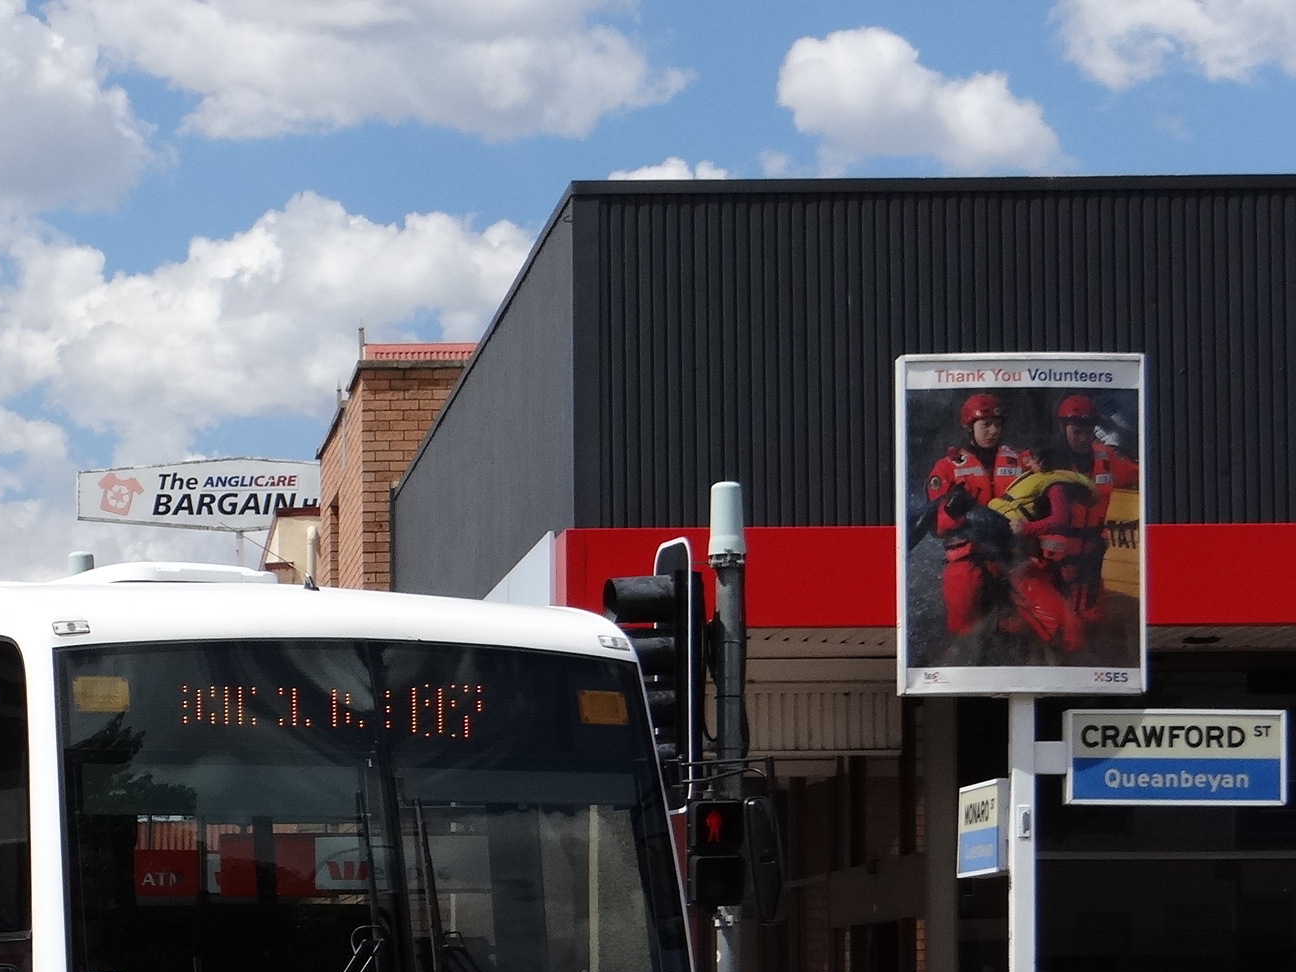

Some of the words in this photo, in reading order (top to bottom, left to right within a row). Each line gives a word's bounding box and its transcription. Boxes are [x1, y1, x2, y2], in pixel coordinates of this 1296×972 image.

[935, 369, 986, 383] Thank
[992, 368, 1022, 382] You
[1027, 368, 1113, 383] Volunteers
[158, 473, 199, 491] The
[203, 475, 298, 489] ANGLICARE
[152, 492, 297, 516] BARGAIN
[1105, 671, 1129, 683] SES
[1080, 725, 1246, 748] CRAWFORD
[1254, 725, 1271, 737] ST
[1104, 768, 1249, 792] Queanbeyan
[964, 799, 990, 826] MONARO
